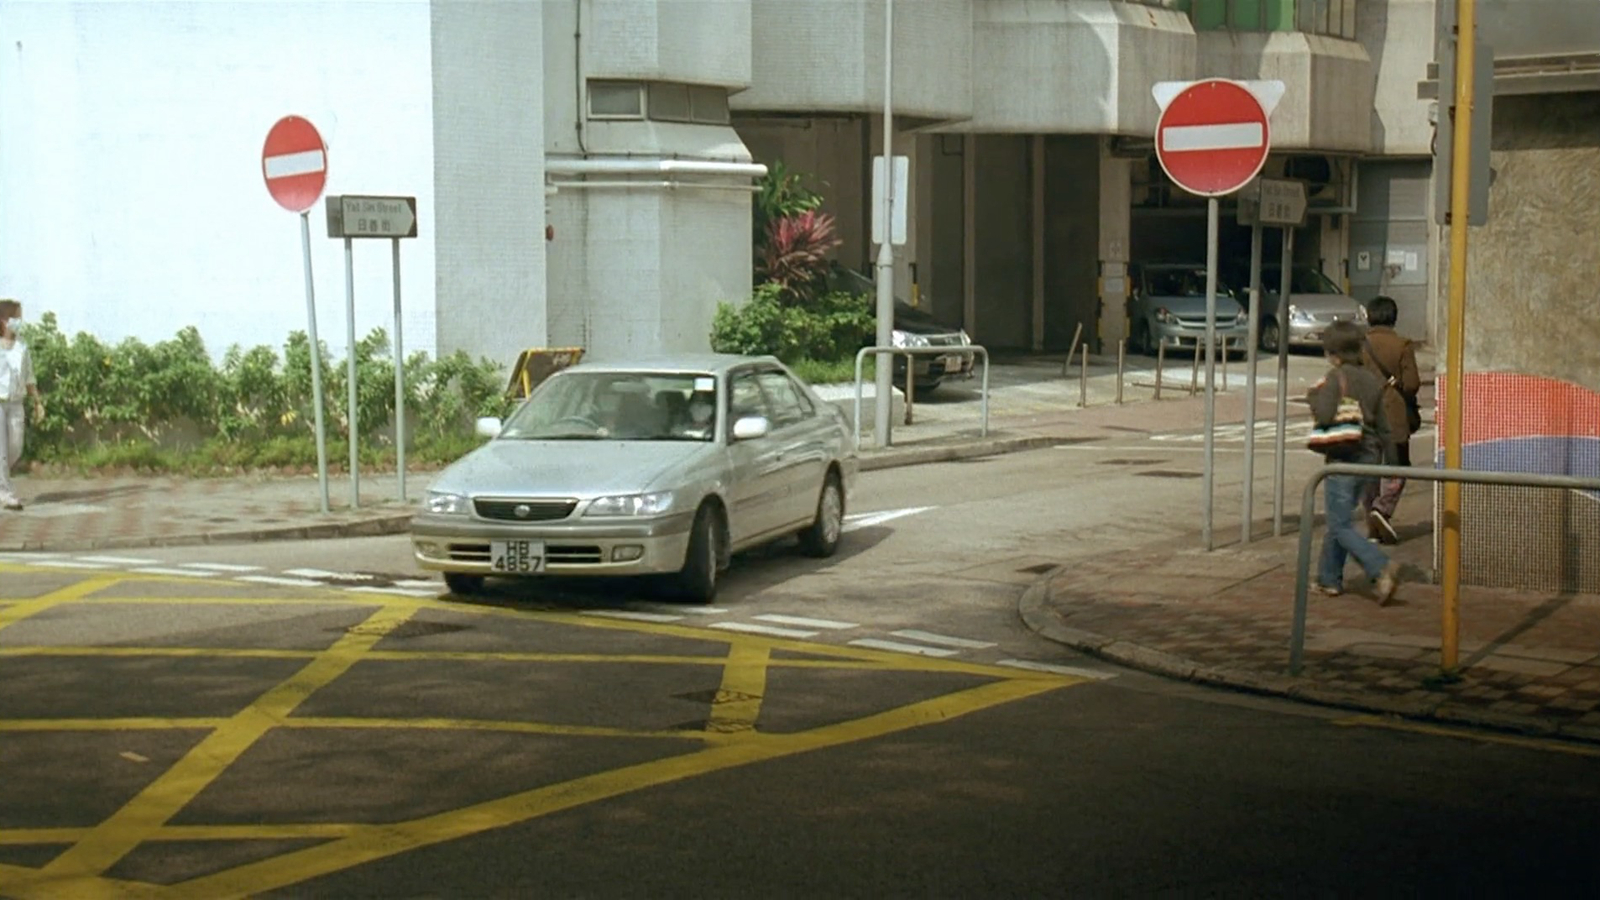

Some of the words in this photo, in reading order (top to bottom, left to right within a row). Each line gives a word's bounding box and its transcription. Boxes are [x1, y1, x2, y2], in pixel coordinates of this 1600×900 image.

[345, 201, 360, 212] Yat
[377, 202, 402, 213] Street
[507, 541, 529, 555] HB
[495, 555, 542, 571] 4857
